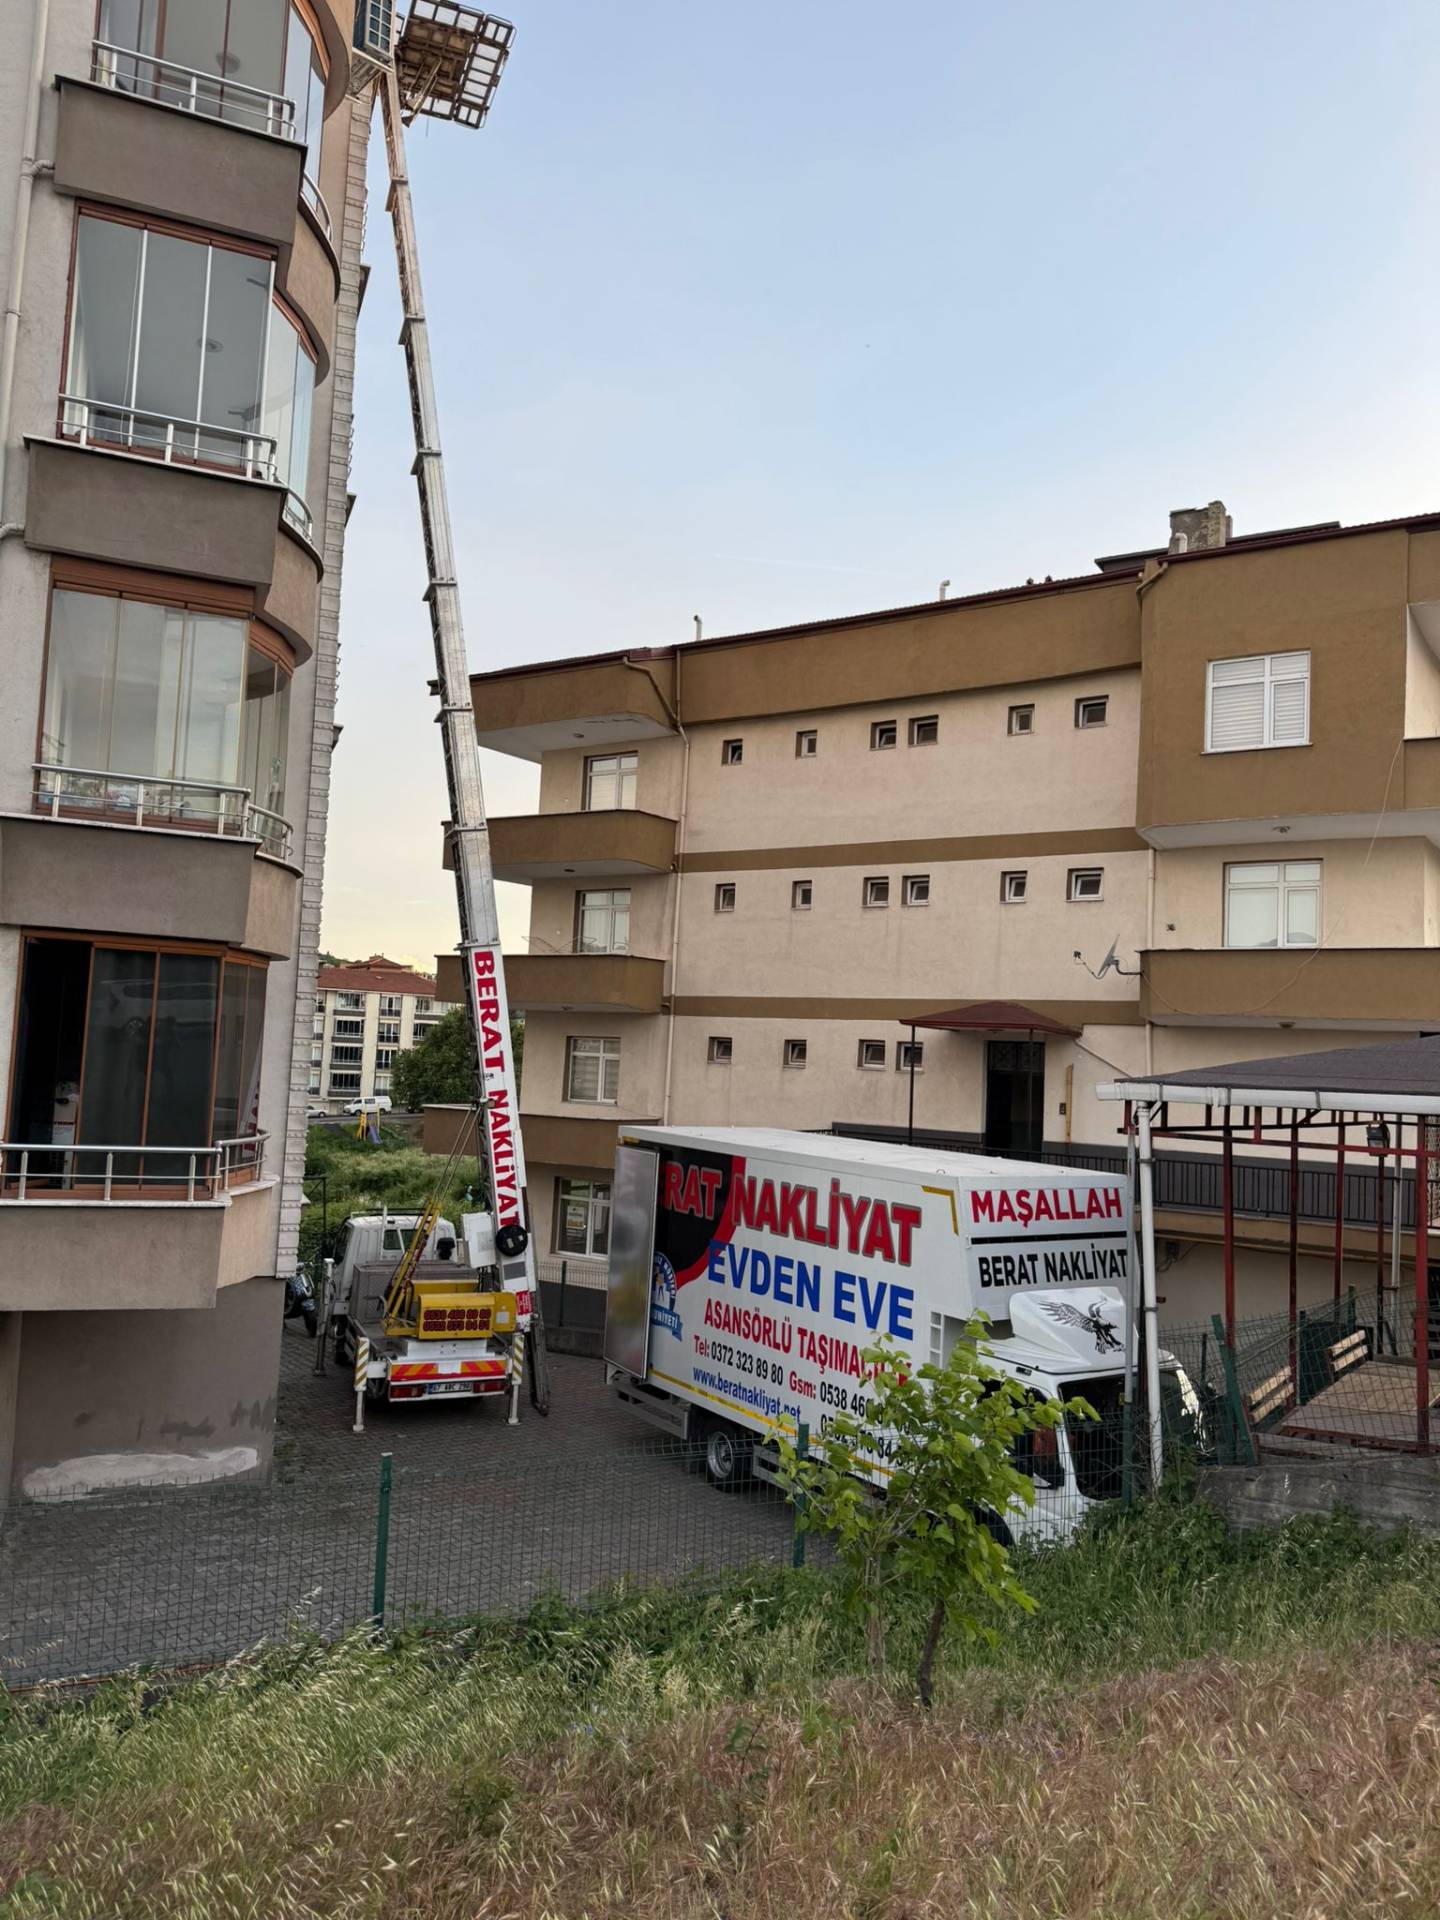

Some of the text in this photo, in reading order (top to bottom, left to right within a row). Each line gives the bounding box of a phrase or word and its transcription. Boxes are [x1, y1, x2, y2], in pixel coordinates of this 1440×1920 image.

[474, 951, 505, 1072] BERAT
[658, 1160, 921, 1267] RAT NAKLİYAT
[970, 1188, 1122, 1228] MAŞALLAH
[707, 1240, 914, 1341] EVDEN EVE
[978, 1243, 1128, 1288] BERAT NAKLİYAT
[704, 1297, 792, 1354] ASANSÖRLÜ
[693, 1334, 710, 1356] Tel:
[711, 1341, 733, 1366] 0372
[736, 1350, 754, 1375] 323
[756, 1357, 768, 1379] 89
[771, 1362, 784, 1386] 80
[789, 1371, 816, 1399] Gsm:
[820, 1381, 848, 1410] 0538
